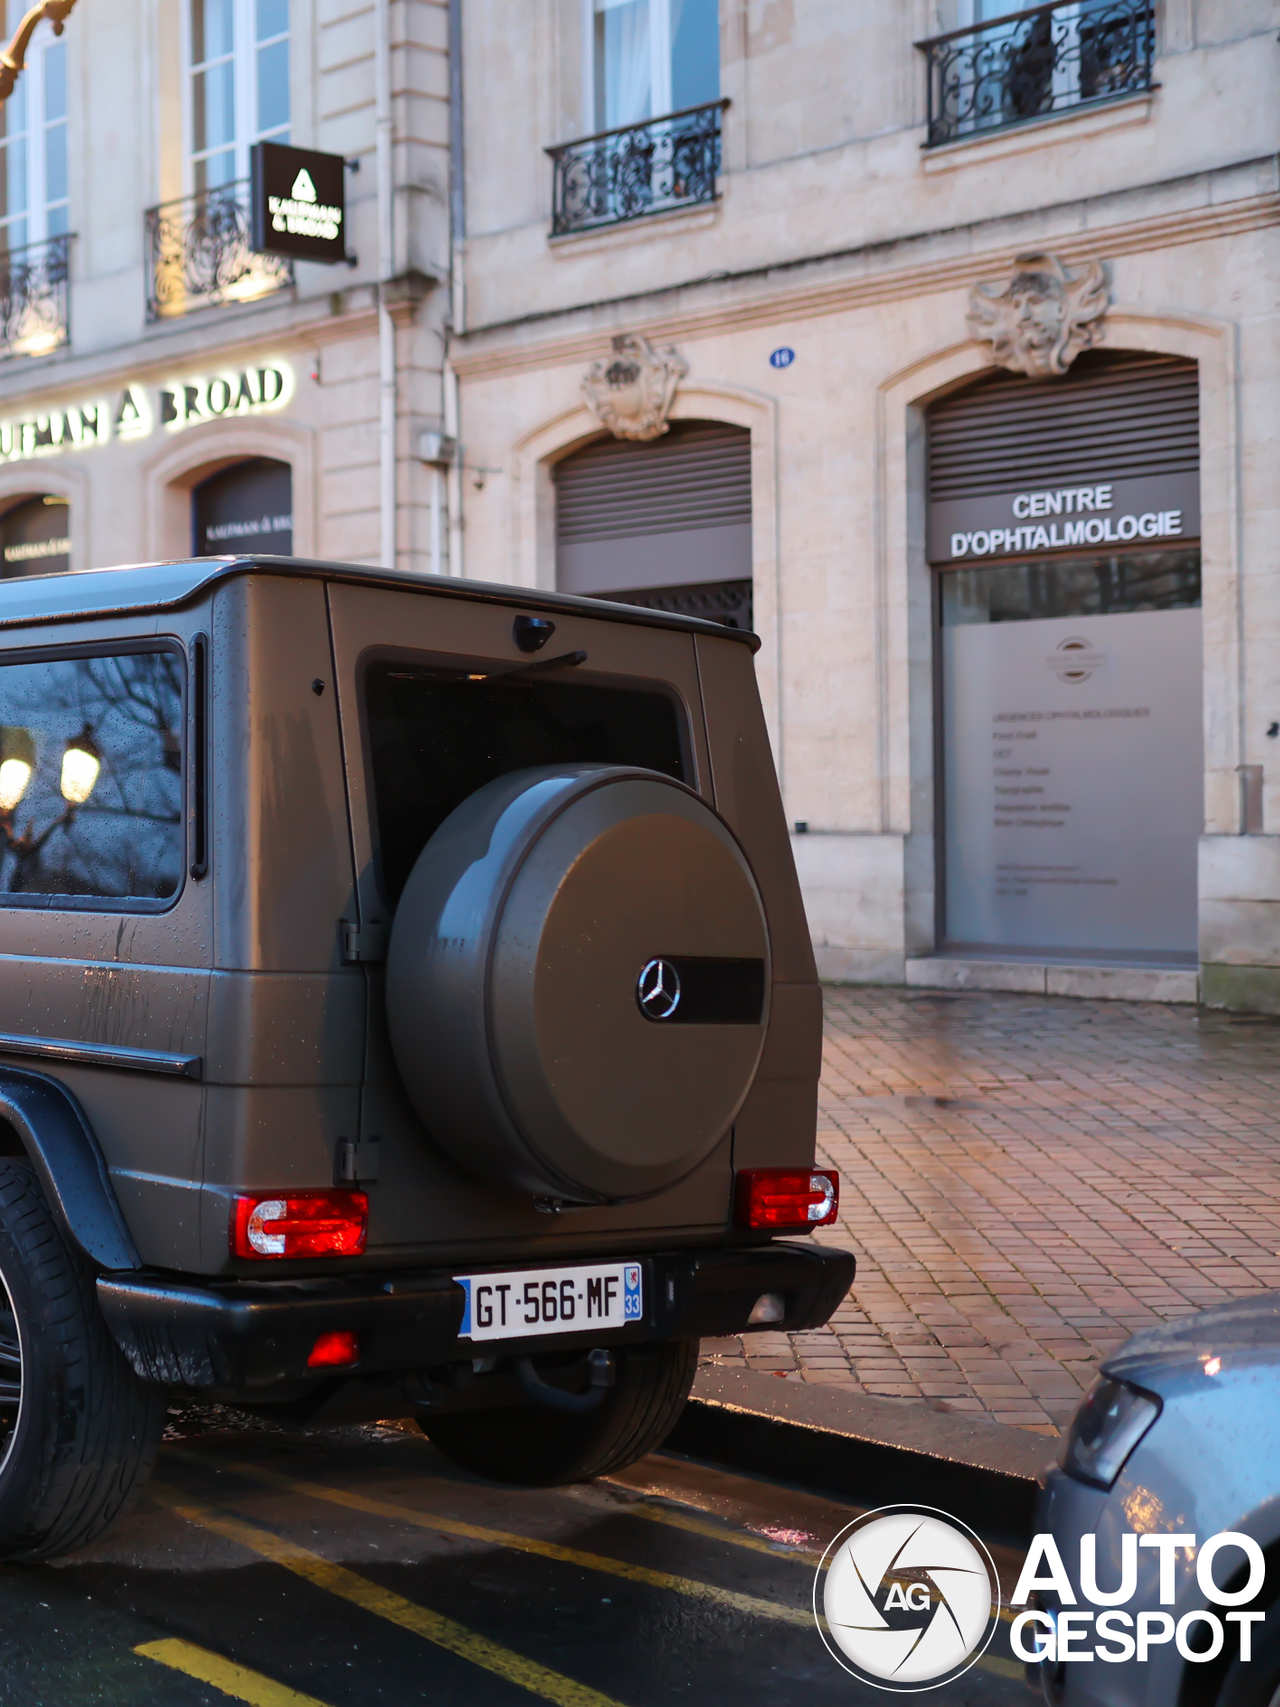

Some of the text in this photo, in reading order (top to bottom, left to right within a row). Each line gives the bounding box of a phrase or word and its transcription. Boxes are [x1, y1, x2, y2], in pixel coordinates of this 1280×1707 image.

[160, 368, 285, 425] BROAD
[1012, 485, 1113, 519] CENTRE
[950, 510, 1183, 557] D'OPHTALMOLOGIE
[476, 1276, 619, 1328] GT-566-MF
[625, 1294, 640, 1314] 33
